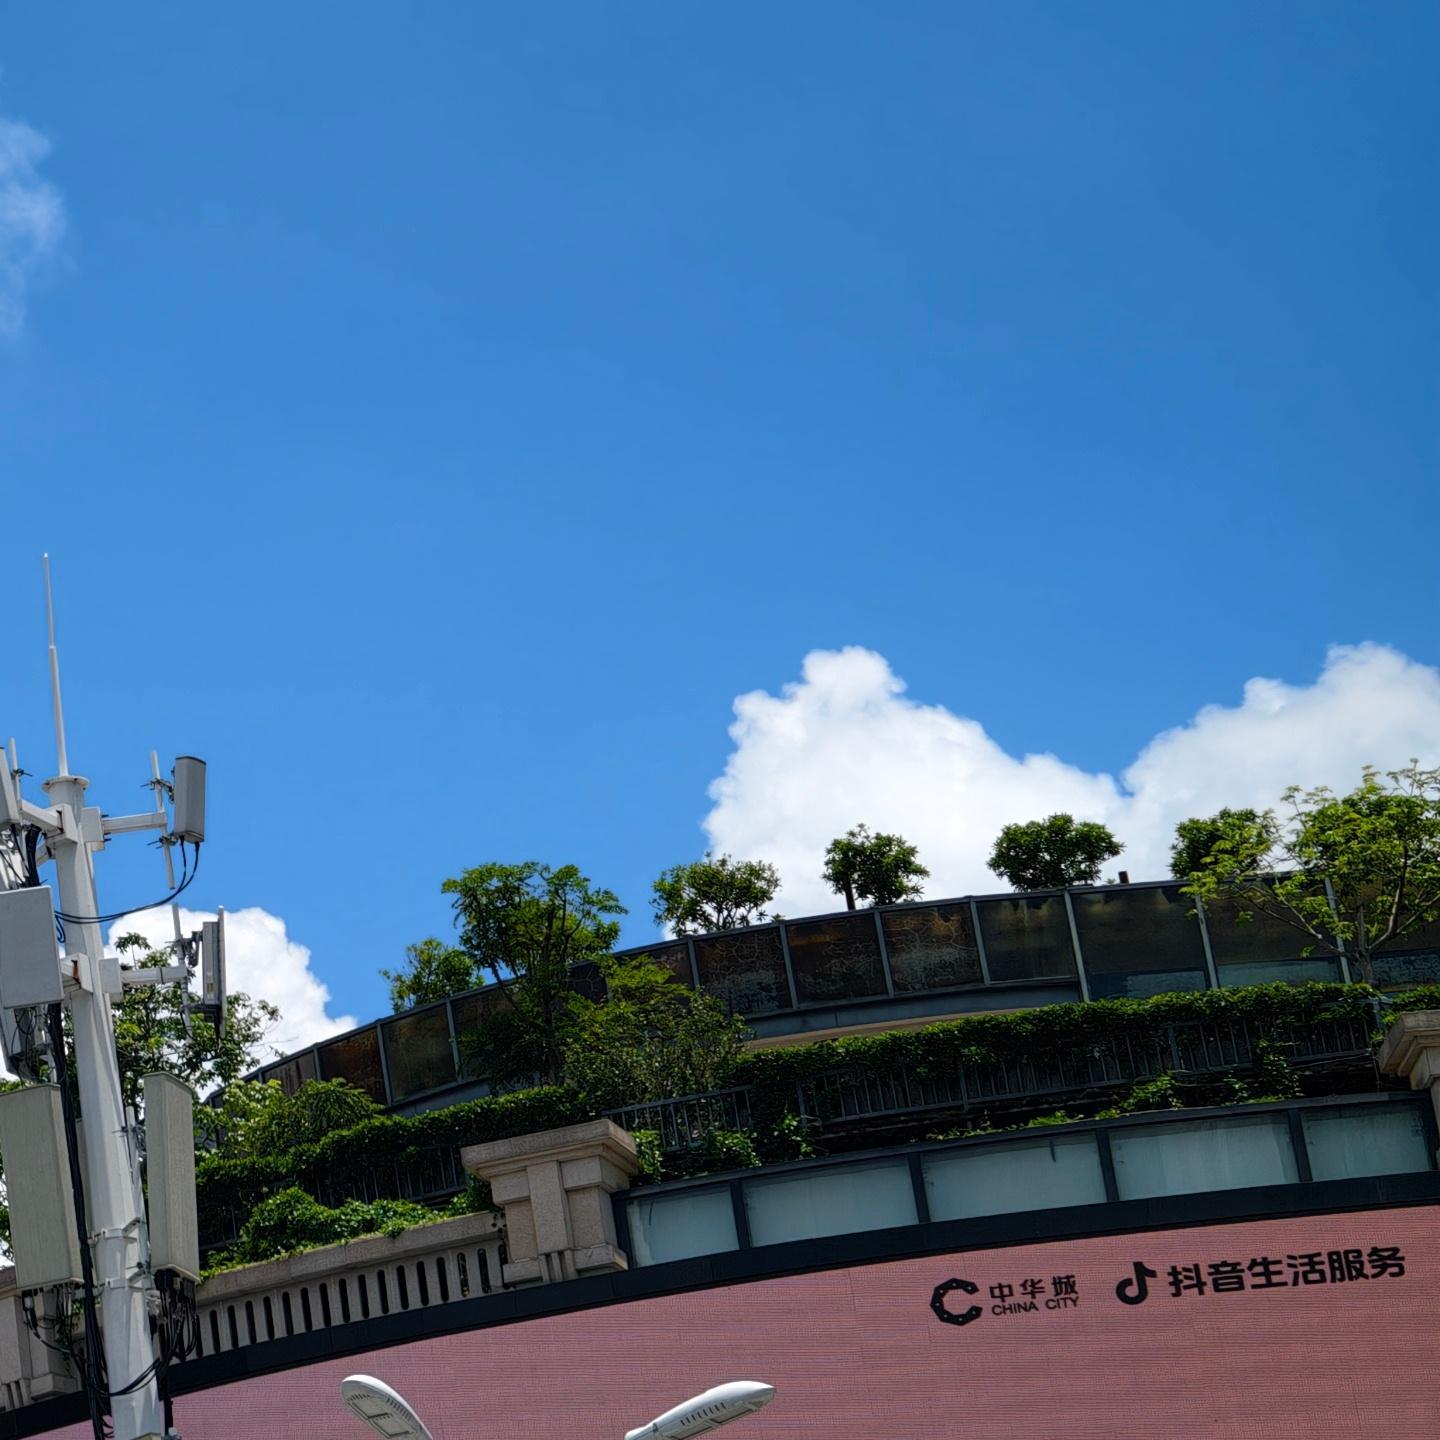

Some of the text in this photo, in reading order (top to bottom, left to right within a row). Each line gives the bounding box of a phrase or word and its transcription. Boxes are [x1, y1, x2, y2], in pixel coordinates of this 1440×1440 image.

[1167, 1246, 1406, 1298] 抖音生活服务
[989, 1274, 1079, 1303] 中华城
[991, 1296, 1080, 1316] CHINA CITY
